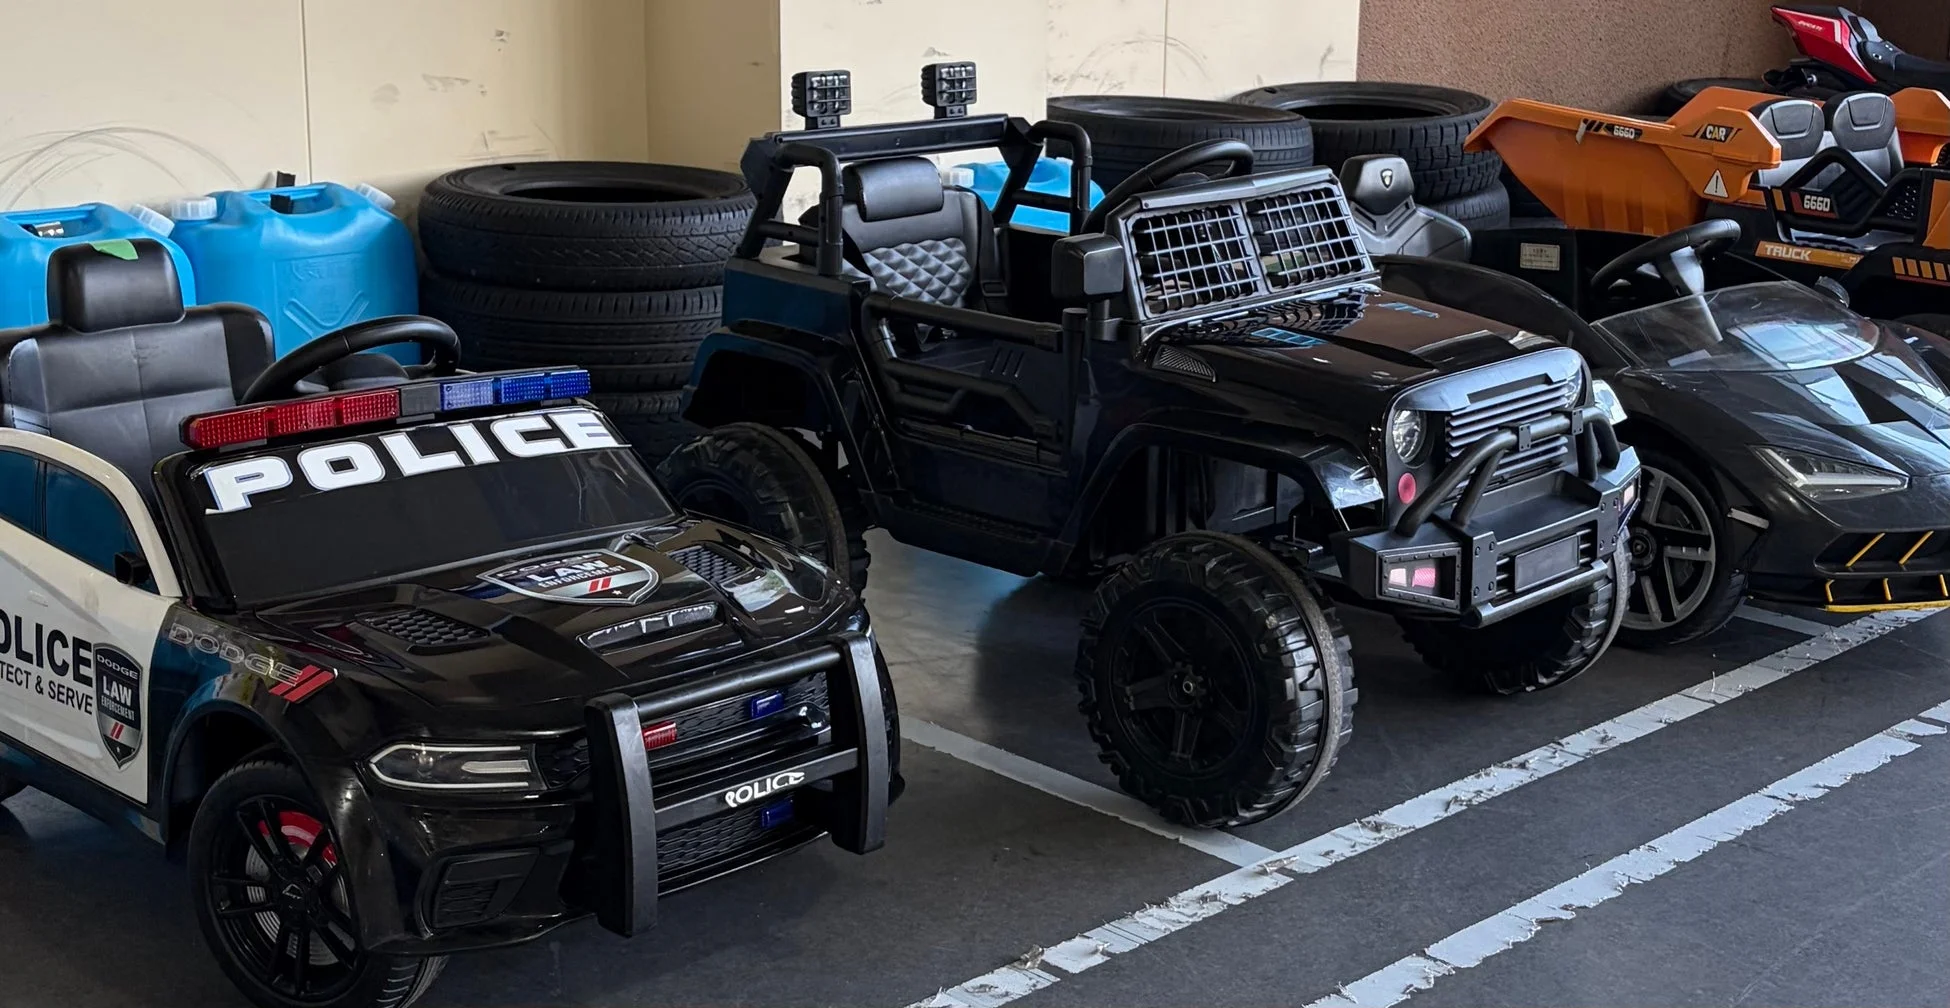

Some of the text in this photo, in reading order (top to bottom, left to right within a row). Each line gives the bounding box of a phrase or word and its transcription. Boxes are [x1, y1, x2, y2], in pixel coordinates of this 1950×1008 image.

[1705, 125, 1726, 141] CAR
[1765, 244, 1812, 261] TRUCK
[205, 411, 632, 514] POLICE
[526, 560, 608, 581] LAW
[538, 565, 626, 588] ENFORCEMENT
[97, 654, 138, 680] DODGE
[168, 622, 303, 687] DODGE
[35, 675, 44, 695] &
[48, 680, 93, 715] SERVE
[102, 675, 132, 707] LAW
[101, 695, 135, 721] ENFORCEMENT
[725, 772, 805, 808] POLICE
